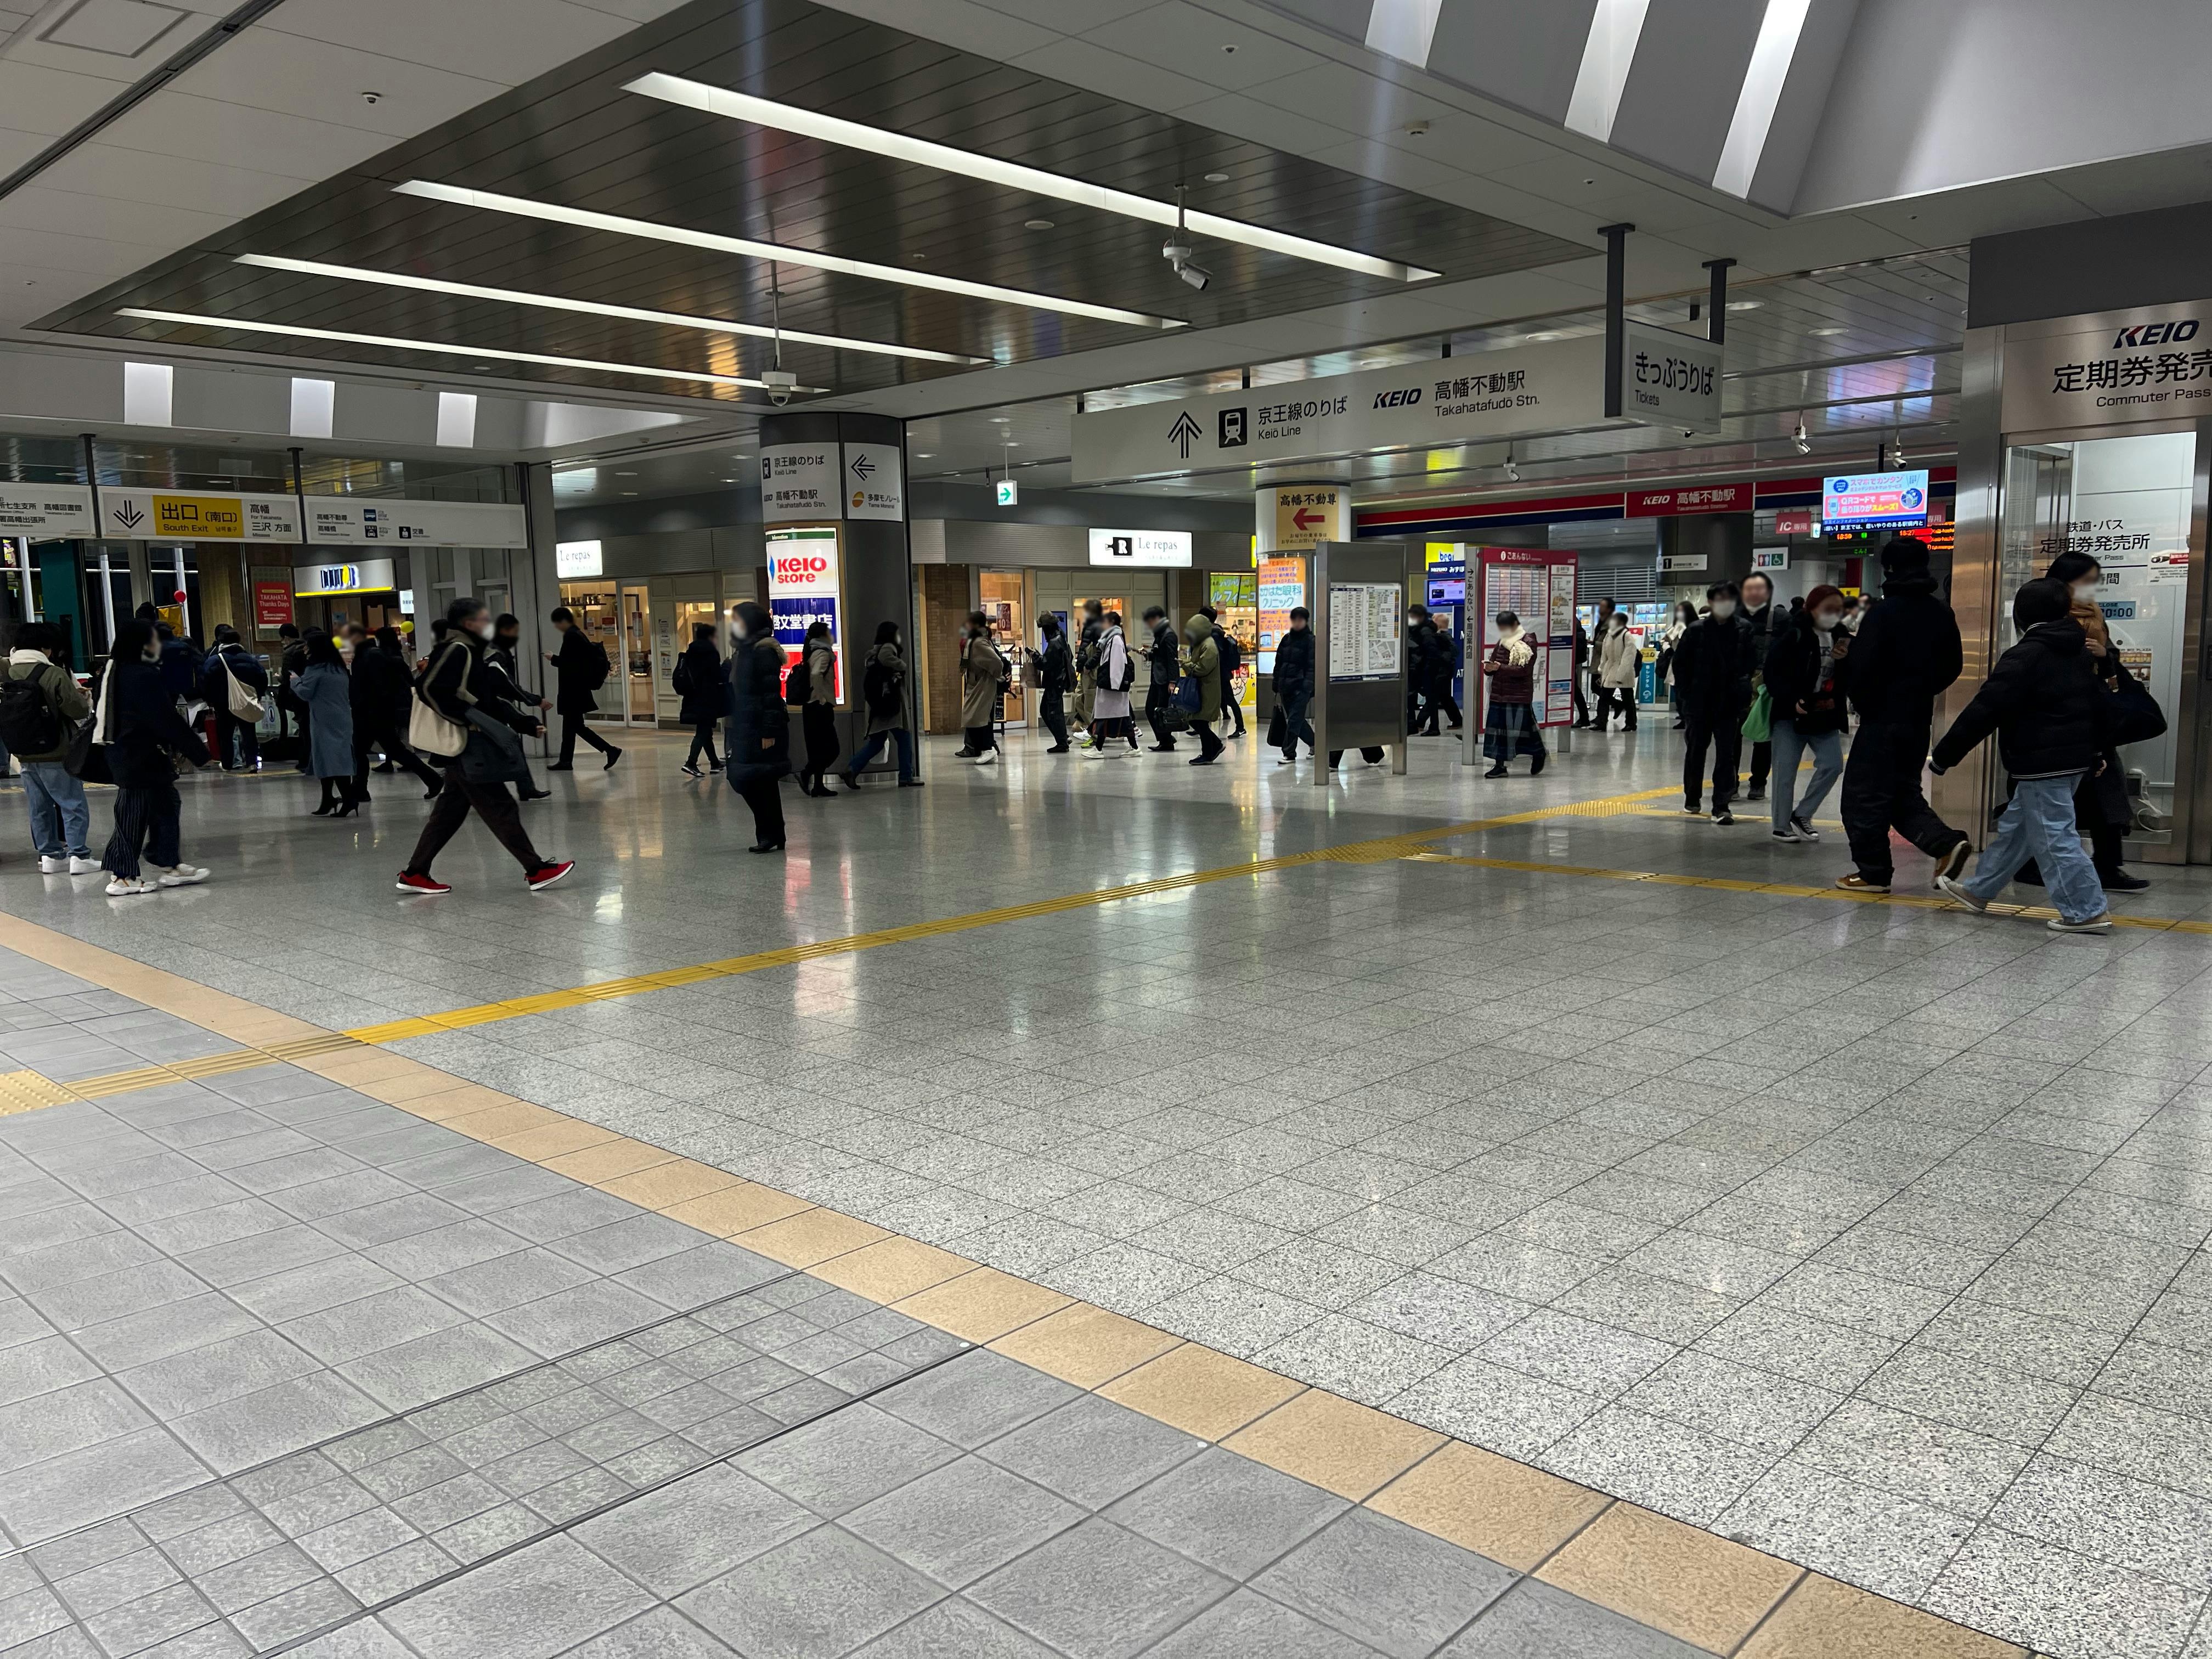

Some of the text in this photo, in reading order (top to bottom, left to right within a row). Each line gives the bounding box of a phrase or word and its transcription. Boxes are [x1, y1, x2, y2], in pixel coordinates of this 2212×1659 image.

[2113, 320, 2199, 349] KEIO
[1635, 351, 1714, 396] きっぷうりば
[2052, 349, 2212, 394] 定期券発売
[1435, 370, 1525, 402] 高幡不動駅
[1373, 388, 1422, 409] KEIO
[1635, 390, 1660, 406] Tickets
[2097, 388, 2211, 408] Commuter Pass
[1258, 395, 1348, 425] 京王線のりば
[1435, 394, 1540, 417] Takahatafudō Stn.
[1258, 426, 1301, 439] Keiō Line
[774, 455, 825, 468] 京王線のりば
[1850, 476, 1903, 487] スマホでカンタン
[776, 489, 818, 501] 高幡不動駅
[1280, 493, 1336, 506] 高幡不動尊
[1643, 495, 1670, 505] KEIO
[1677, 488, 1735, 504] 高幡不動駅
[1841, 496, 1876, 505] QRコードで
[161, 502, 199, 521] 出口
[250, 504, 270, 514] 高幡
[163, 523, 189, 532] South
[252, 522, 292, 532] 三沢 方面
[1779, 522, 1792, 531] IC
[2066, 519, 2124, 533] 鉄道・バス
[1138, 537, 1178, 552] Le repas
[2040, 533, 2151, 554] 定期券発売所
[560, 550, 591, 563] Le repas
[1507, 551, 1531, 561] ごあんない
[777, 573, 816, 584] store
[1263, 597, 1294, 608] クリニック
[2102, 607, 2133, 618] 0:00
